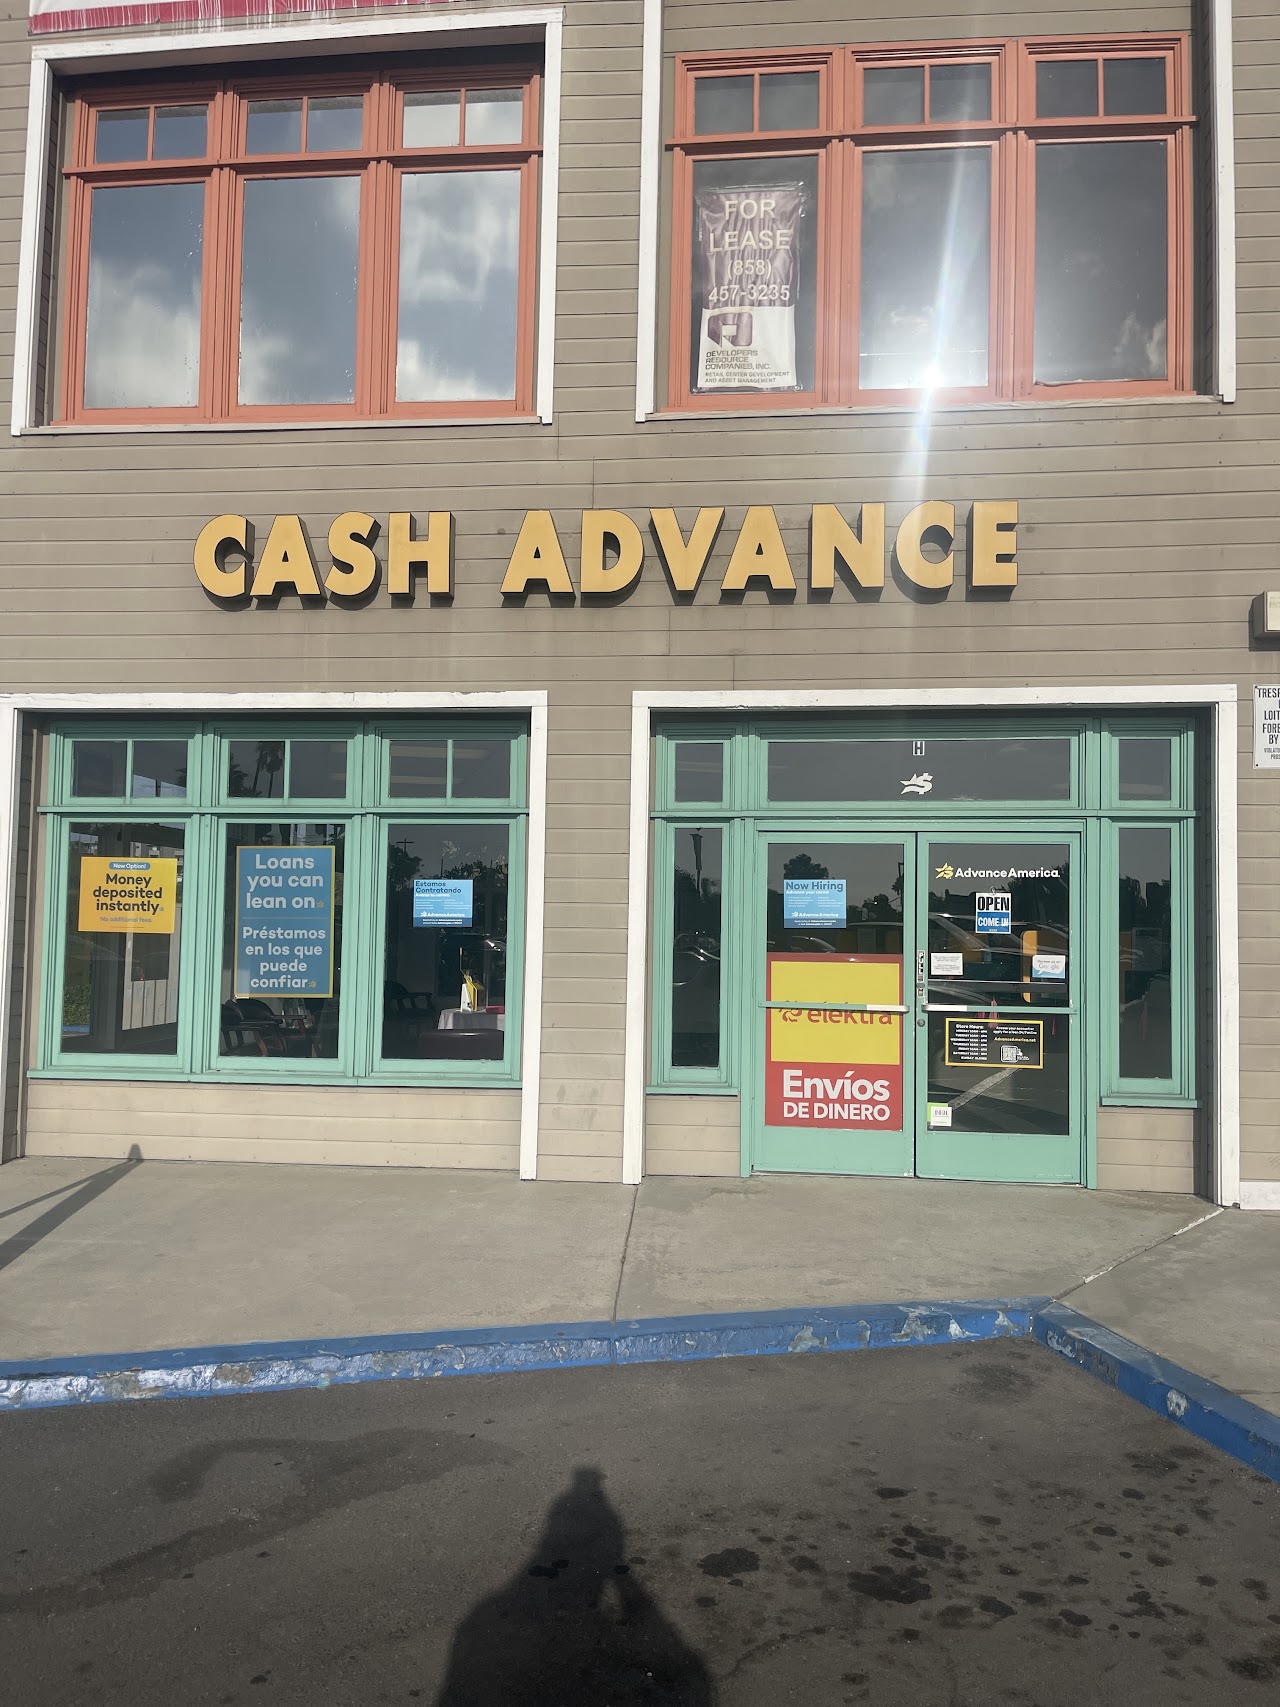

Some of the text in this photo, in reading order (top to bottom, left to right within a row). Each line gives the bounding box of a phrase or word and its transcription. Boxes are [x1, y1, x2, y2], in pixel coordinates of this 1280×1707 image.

[725, 200, 776, 220] FOR
[709, 229, 793, 251] LEASE
[728, 259, 772, 279] (858)
[708, 284, 790, 302] 457-3235
[194, 501, 1019, 600] CASH ADVANCE
[1268, 734, 1279, 744] BY
[913, 741, 925, 755] H
[255, 853, 315, 870] Loans
[106, 873, 152, 888] Money
[247, 875, 324, 892] you can
[785, 881, 844, 892] Now Hiring
[93, 885, 162, 901] deposited
[246, 892, 315, 909] lean on
[96, 898, 160, 915] instantly
[977, 896, 1010, 911] OPEN
[978, 917, 1000, 927] COME
[242, 926, 326, 940] Préstamos
[245, 943, 323, 959] en los que
[259, 959, 308, 975] puede
[250, 974, 309, 988] confiar
[807, 1001, 893, 1025] elektra
[783, 1069, 890, 1102] Envíos
[783, 1101, 891, 1121] DE DINERO
